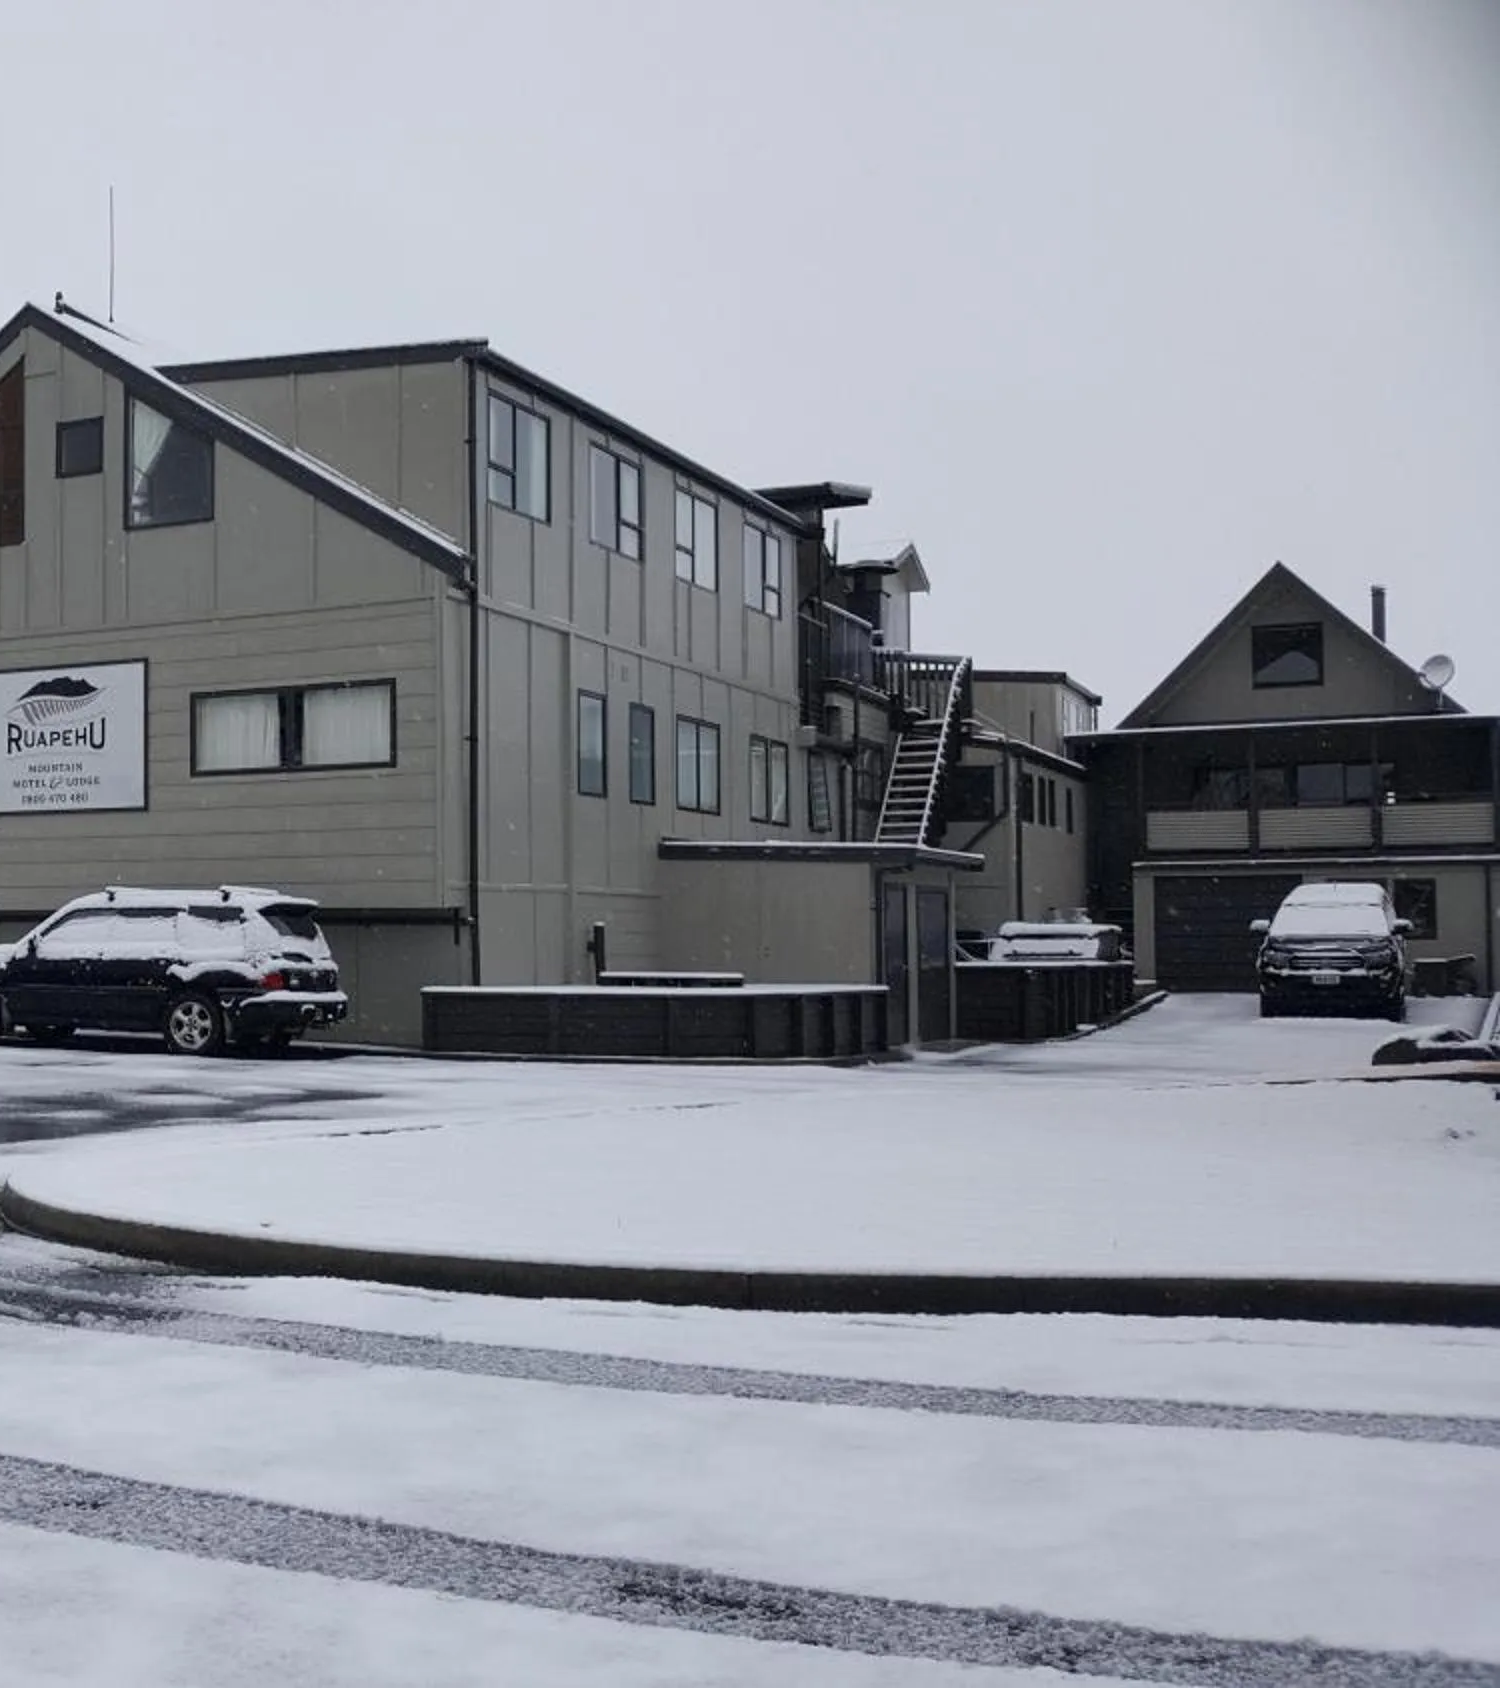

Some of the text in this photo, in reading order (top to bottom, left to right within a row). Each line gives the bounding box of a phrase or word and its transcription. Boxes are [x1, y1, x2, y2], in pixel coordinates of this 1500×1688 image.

[6, 717, 107, 755] RUAPEHU
[27, 762, 84, 774] MOUNTAIN
[12, 779, 48, 789] MOTEL
[65, 775, 101, 788] LODGE
